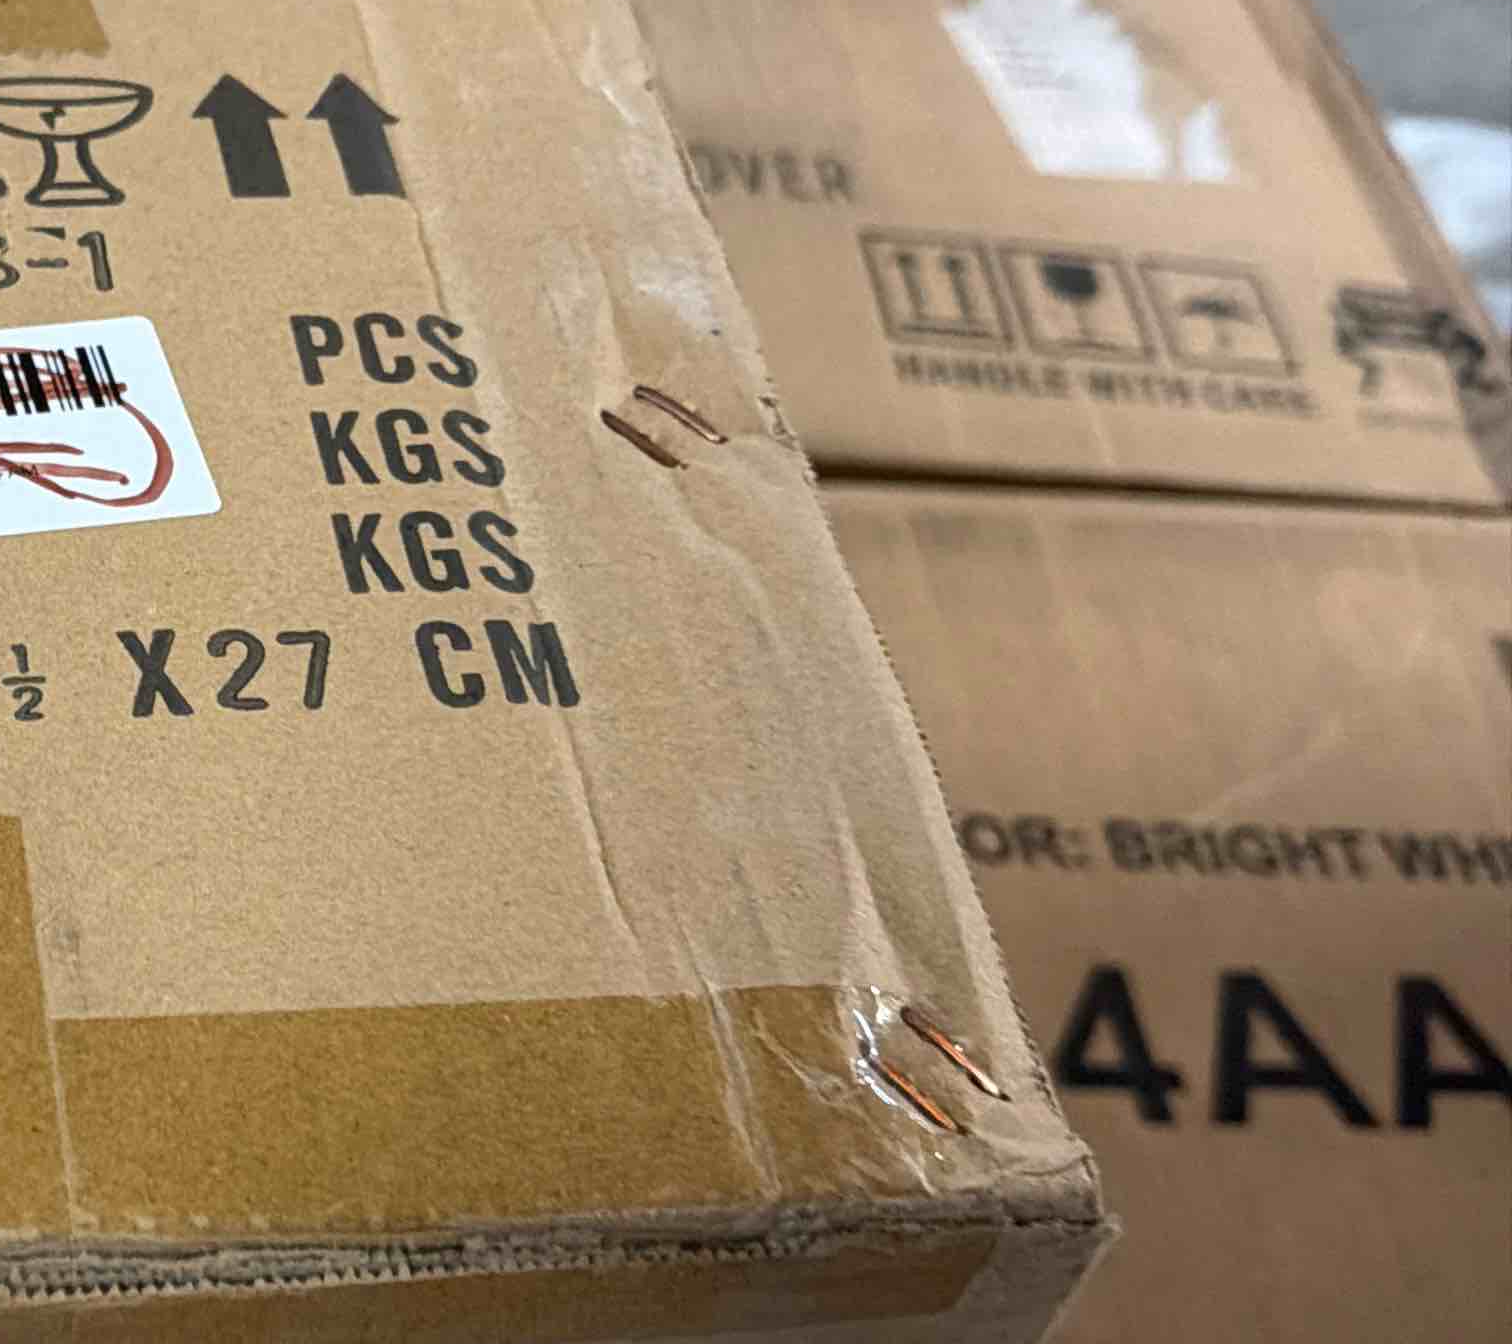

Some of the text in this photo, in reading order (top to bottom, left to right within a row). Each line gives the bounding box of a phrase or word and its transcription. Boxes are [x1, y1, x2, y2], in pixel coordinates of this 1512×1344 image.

[290, 312, 478, 388] PCS
[309, 408, 506, 488] KGS
[331, 510, 535, 594] KGS
[414, 619, 581, 708] CM
[1103, 815, 1370, 880] BRIGHT
